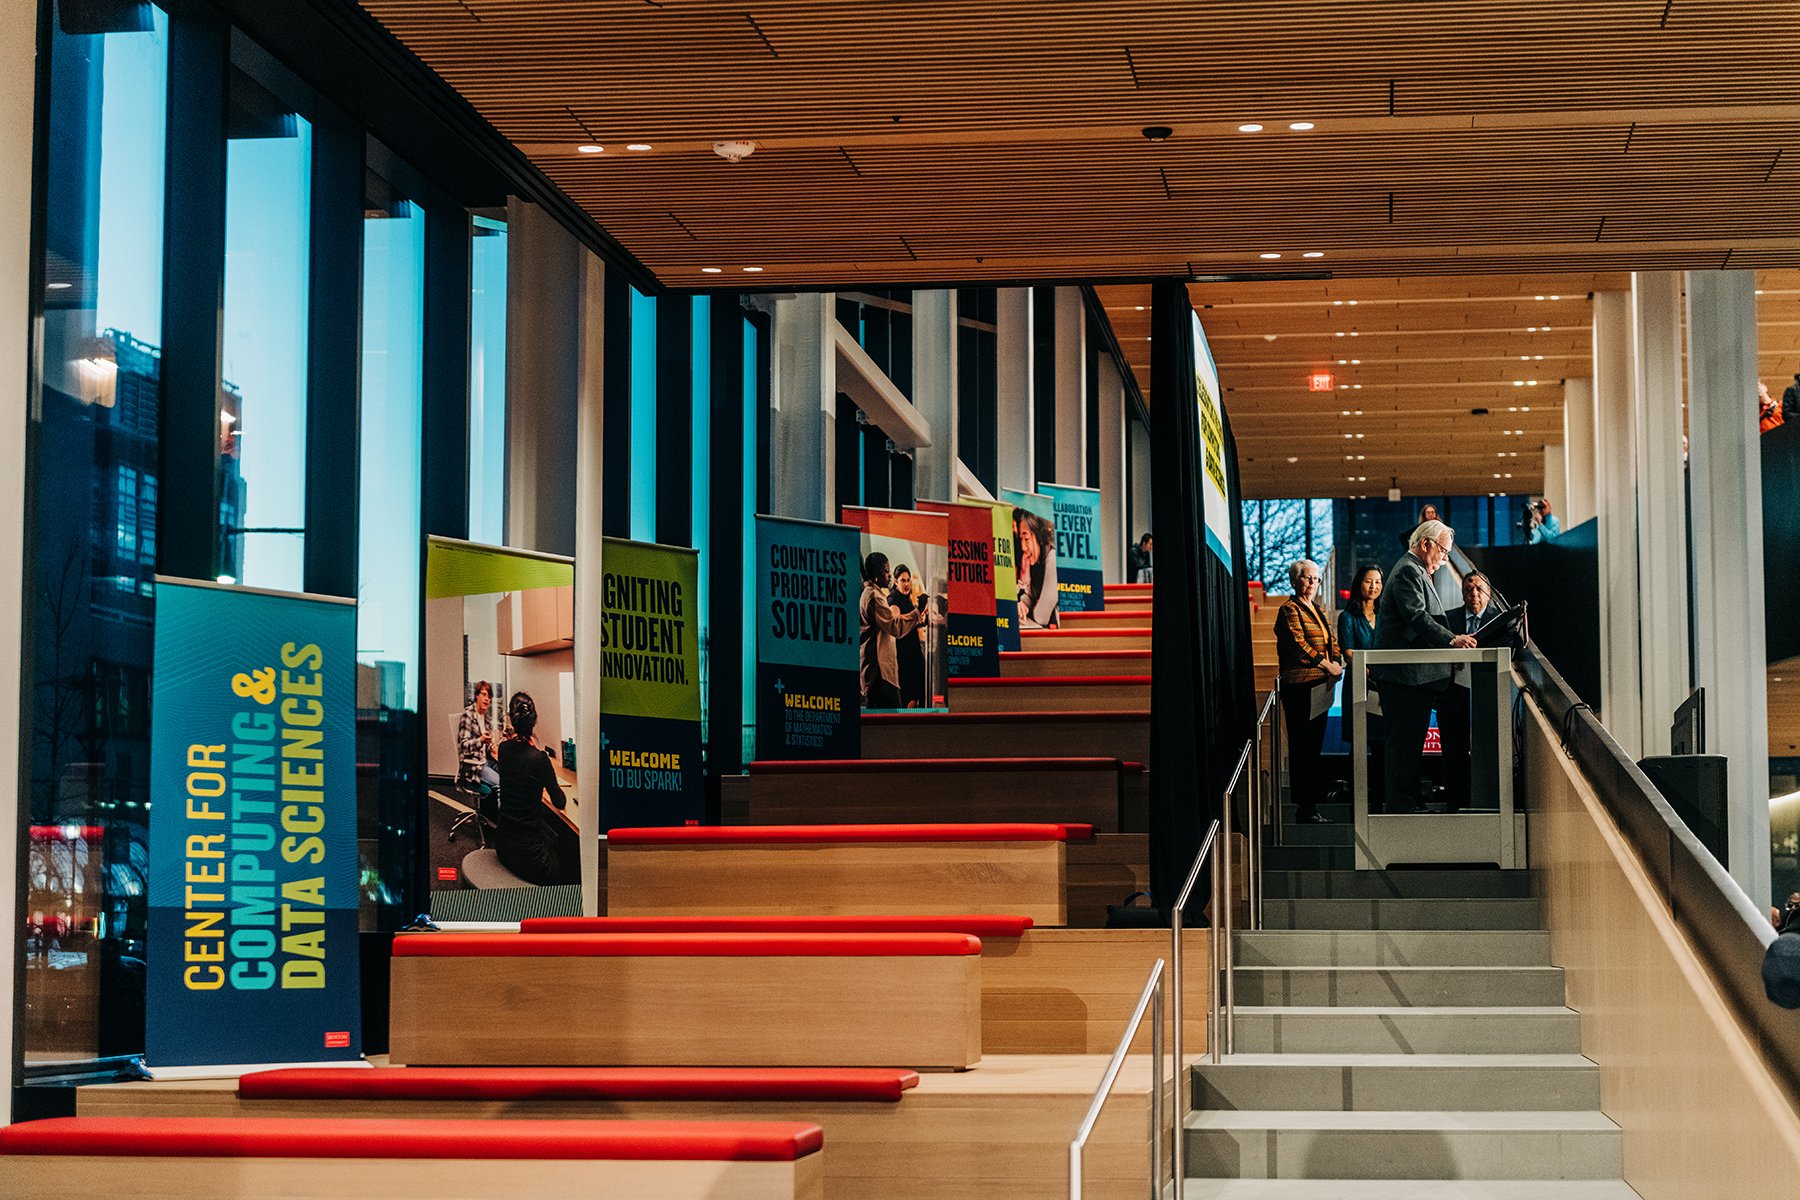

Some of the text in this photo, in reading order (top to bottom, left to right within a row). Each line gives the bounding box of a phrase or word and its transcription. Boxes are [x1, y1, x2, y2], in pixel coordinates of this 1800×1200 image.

[1312, 375, 1330, 389] EXIT
[1053, 502, 1093, 515] LLABORATION
[1053, 513, 1093, 533] T EVERY
[770, 543, 847, 577] COUNTLESS
[1056, 531, 1098, 561] EVEL.
[948, 561, 992, 584] FUTURE.
[603, 572, 683, 617] GNITING
[770, 571, 847, 605] PROBLEMS
[601, 610, 684, 655] STUDENT
[771, 600, 852, 645] SOLVED.
[947, 634, 984, 647] ELCOME
[785, 693, 841, 711] WELCOME
[609, 749, 681, 770] WELCOME
[609, 767, 682, 791] TO BU SPARK!
[229, 666, 277, 990] COMPUTING &
[281, 641, 326, 990] DATA SCIENCES
[184, 743, 226, 991] CENTER FOR
